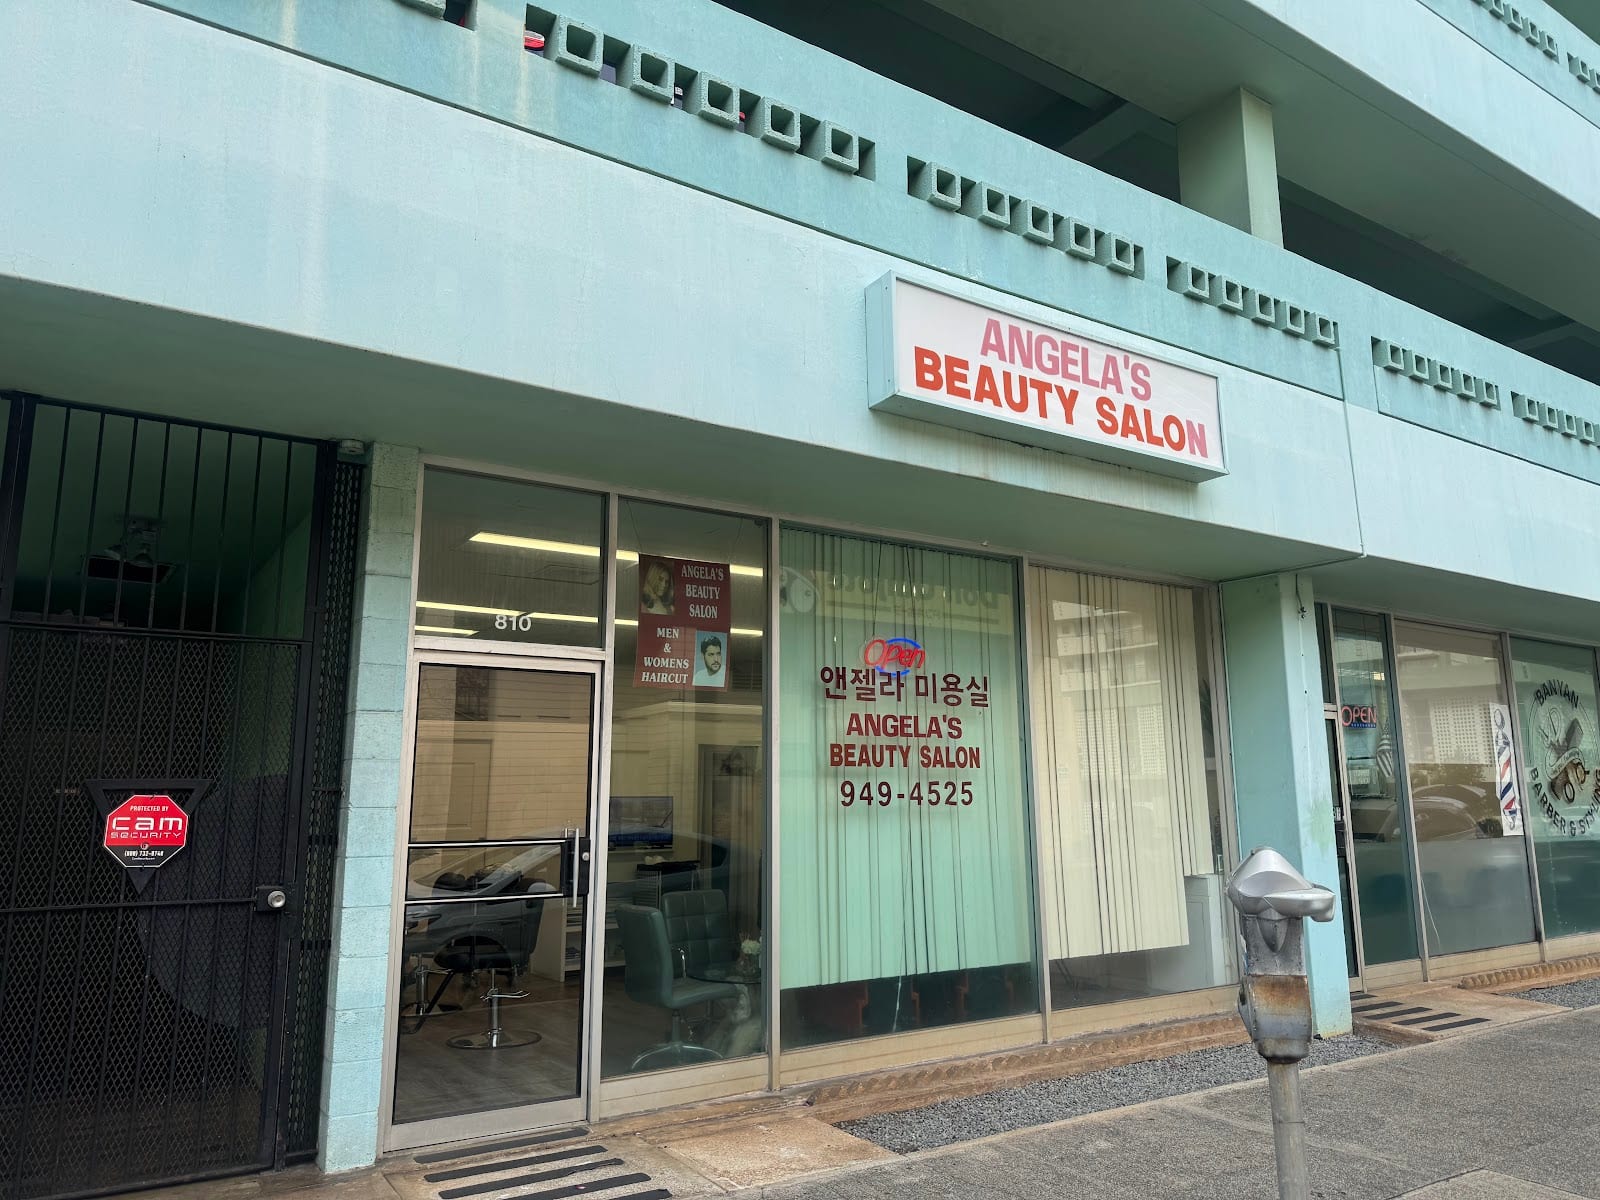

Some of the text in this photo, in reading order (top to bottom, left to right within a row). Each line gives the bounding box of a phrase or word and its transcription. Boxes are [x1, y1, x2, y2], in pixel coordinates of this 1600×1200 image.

[980, 318, 1152, 401] ANGELA'S
[914, 345, 1209, 458] BEAUTY SALON
[681, 564, 724, 581] ANGELA'S
[685, 584, 721, 600] BEAUTY
[689, 604, 718, 619] SALON
[494, 614, 532, 631] 810
[656, 627, 680, 639] MEN
[663, 642, 672, 653] &
[643, 656, 690, 670] WOMENS
[641, 672, 689, 684] HAIRCUT
[820, 666, 989, 707] 앤젤라 미용실
[1534, 679, 1579, 709] BANYAN
[1341, 705, 1377, 726] OPEN
[846, 713, 963, 740] ANGELA'S
[830, 743, 981, 769] BEAUTY SALON
[840, 780, 973, 807] 949-4525
[1530, 767, 1566, 834] BARBER
[1569, 820, 1577, 837] &
